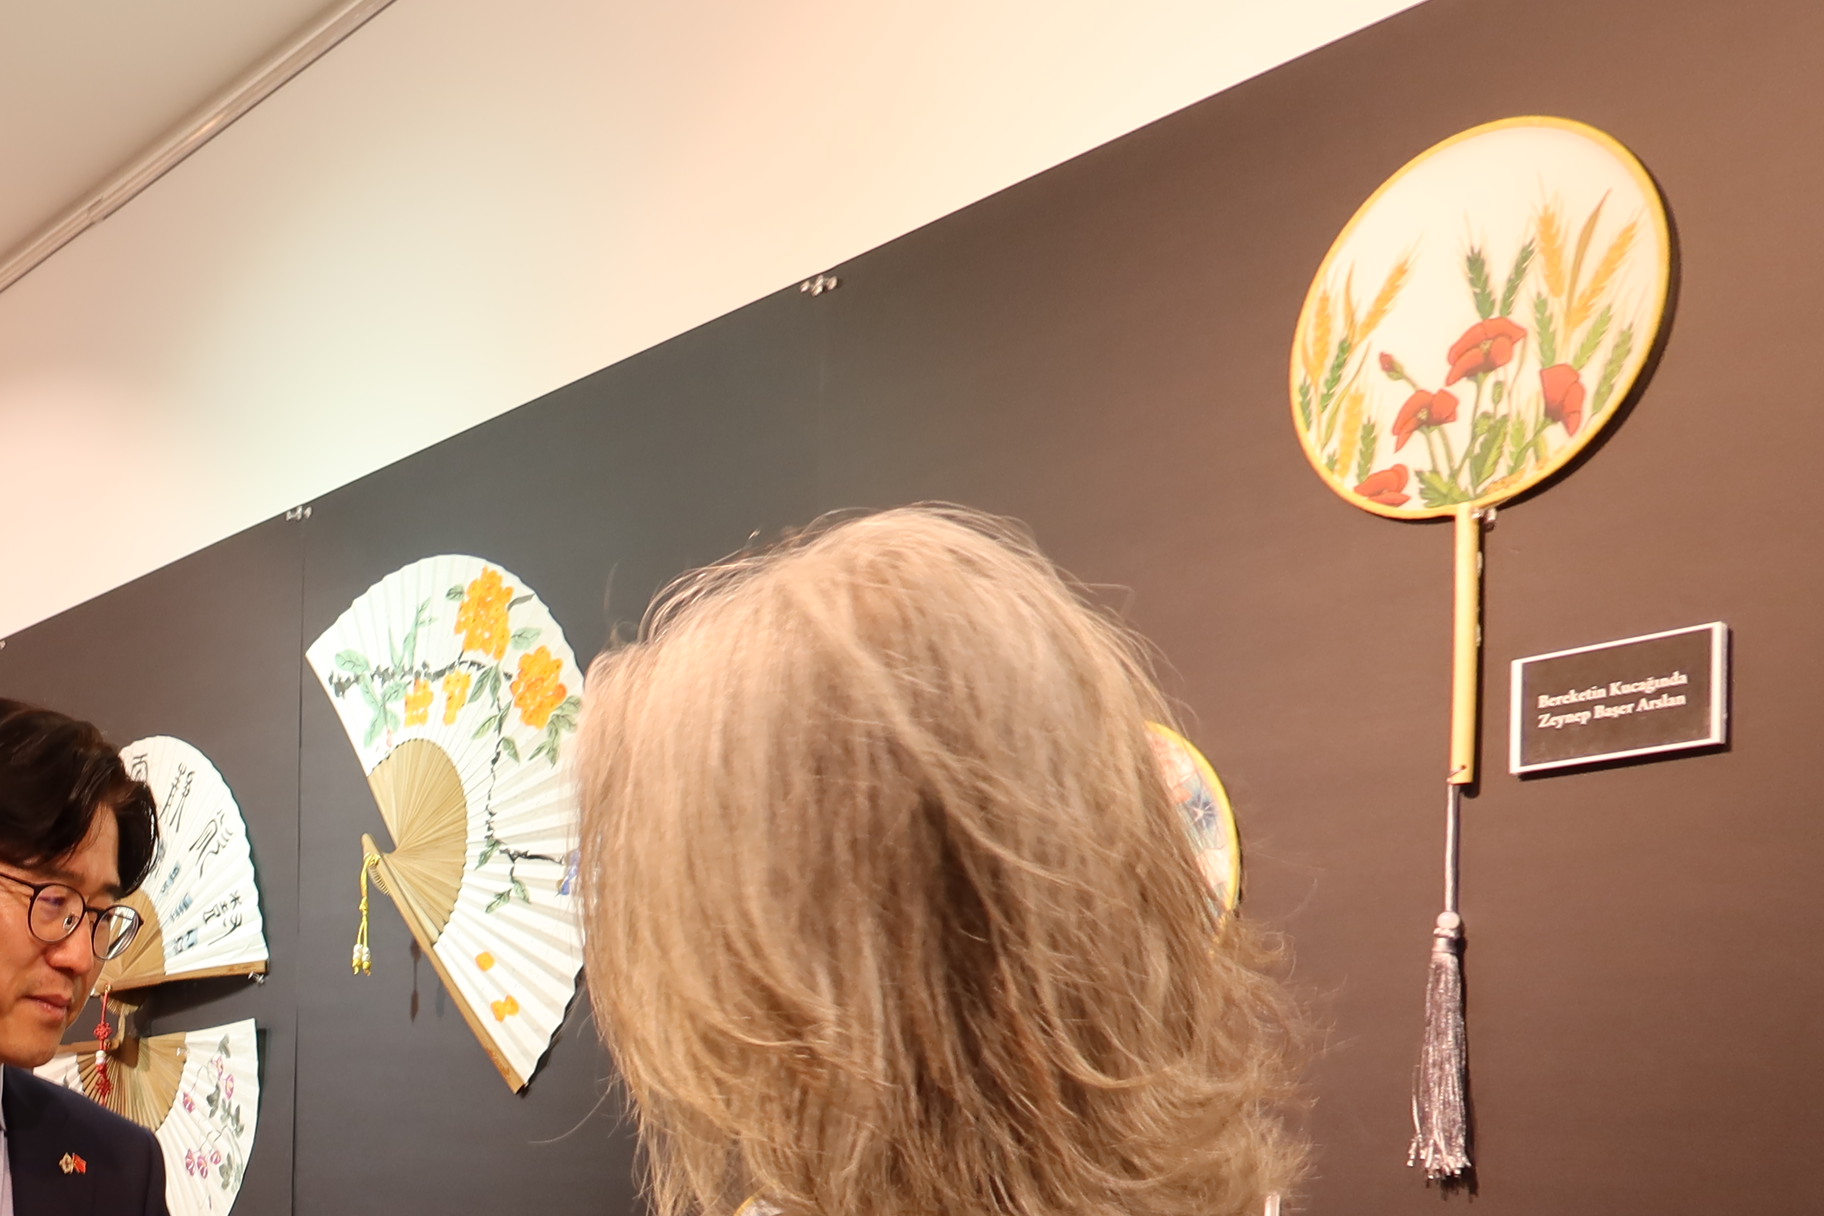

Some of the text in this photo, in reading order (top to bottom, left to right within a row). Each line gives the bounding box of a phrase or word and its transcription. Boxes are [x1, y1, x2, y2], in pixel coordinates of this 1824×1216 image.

[1537, 687, 1606, 708] Bereketin
[1537, 694, 1686, 728] Zeynep Başer Arslan
